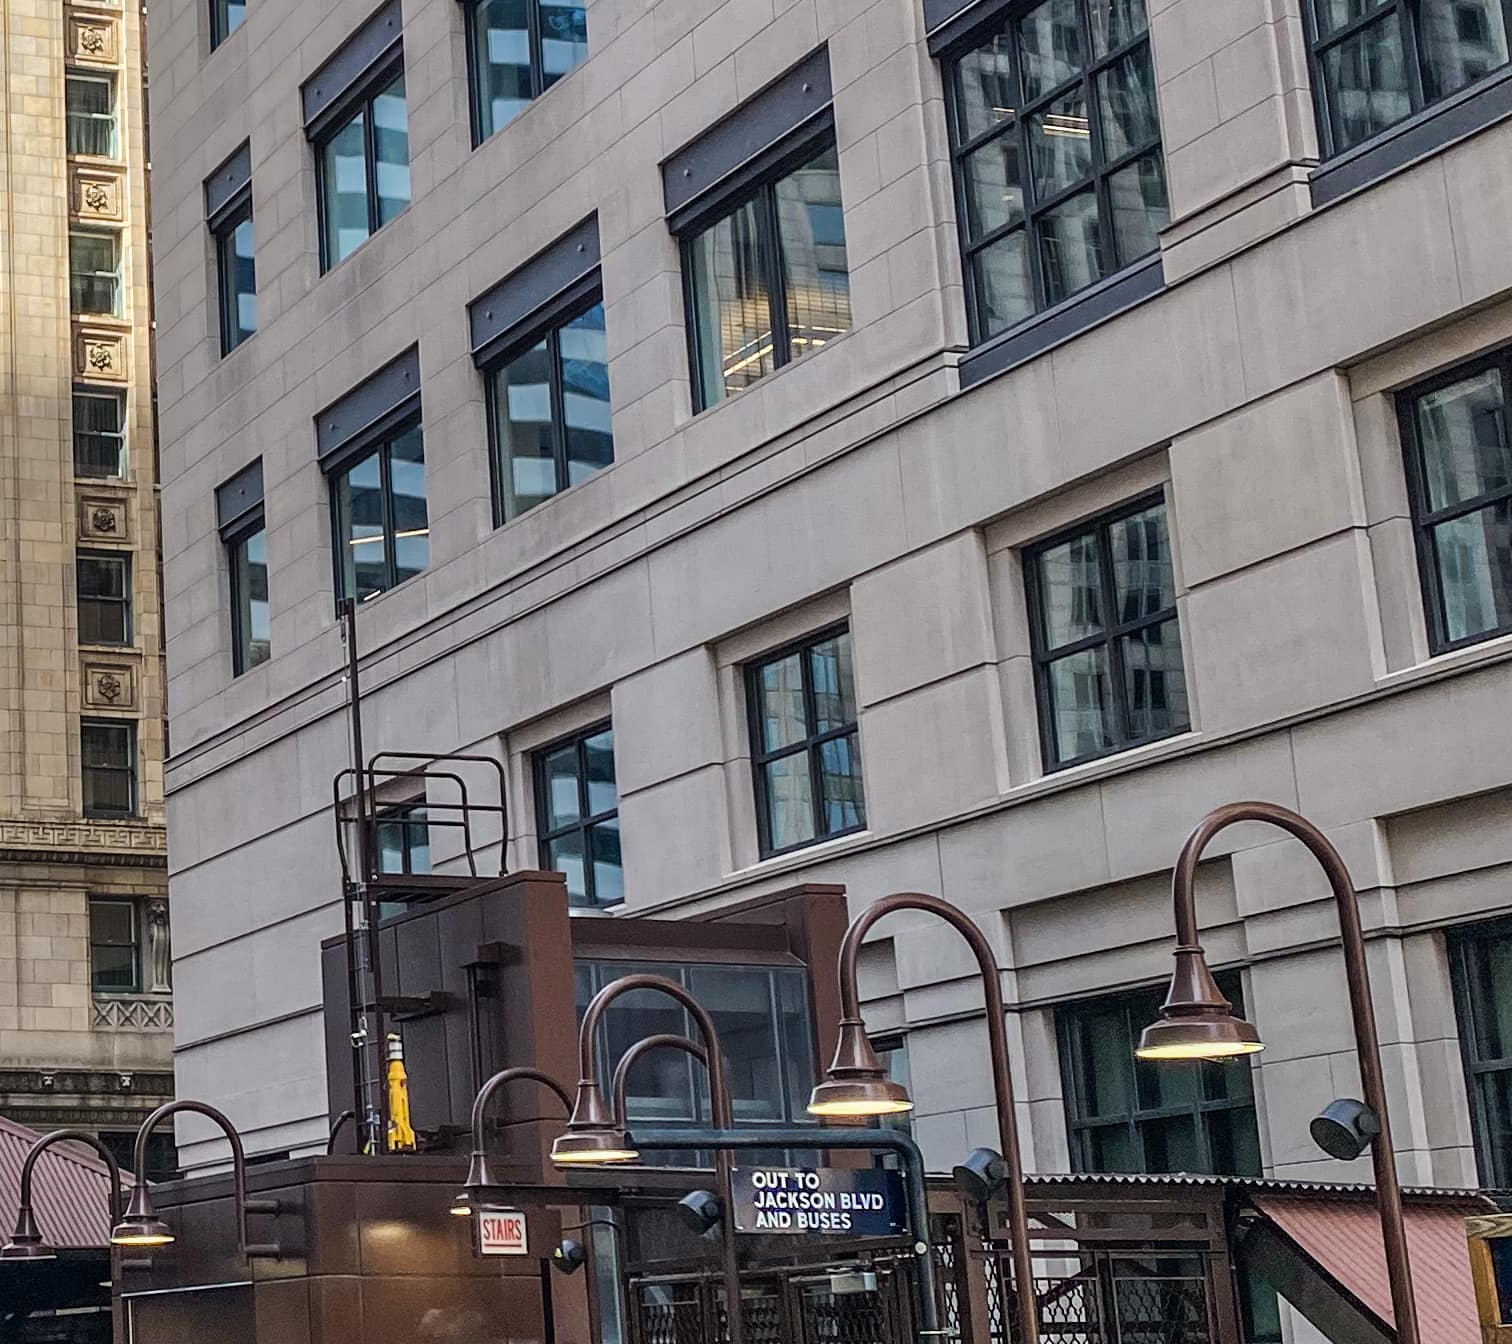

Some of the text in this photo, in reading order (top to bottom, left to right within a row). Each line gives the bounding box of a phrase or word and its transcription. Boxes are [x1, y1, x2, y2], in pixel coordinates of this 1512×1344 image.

[752, 1171, 820, 1189] OUT TO
[754, 1191, 884, 1210] JACKSON BLVD
[483, 1219, 522, 1241] STAIRS
[756, 1211, 852, 1230] AND BUSES
